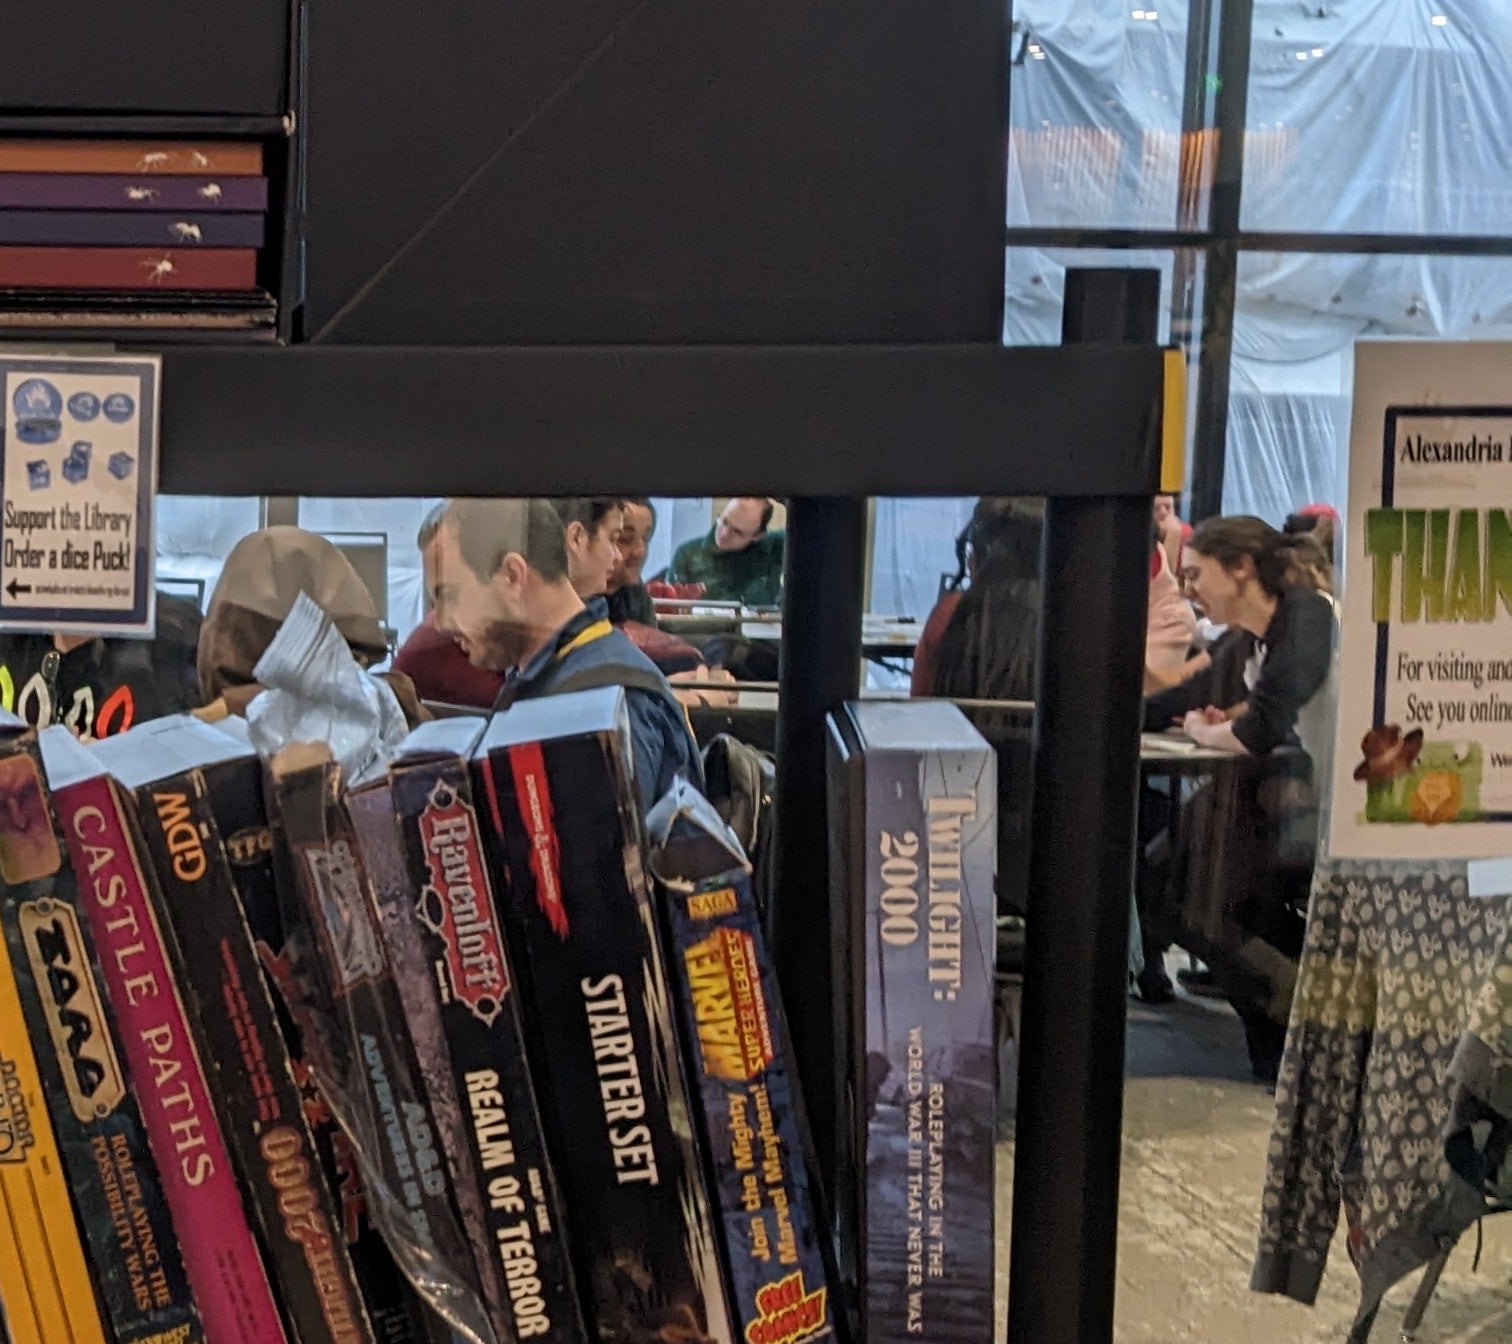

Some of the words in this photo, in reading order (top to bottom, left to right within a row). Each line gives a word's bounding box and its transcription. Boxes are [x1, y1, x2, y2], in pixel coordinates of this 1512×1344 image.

[1400, 434, 1503, 463] Alexandria
[4, 539, 46, 567] Order
[49, 550, 57, 568] a
[62, 540, 89, 569] dice
[93, 545, 131, 571] Puck!
[5, 501, 56, 535] Support
[60, 504, 80, 530] the
[84, 502, 131, 538] Library
[1396, 652, 1423, 683] For
[1427, 652, 1483, 687] visiting
[1406, 694, 1434, 722] See
[1438, 697, 1466, 729] you
[153, 790, 208, 883] GDW
[531, 831, 551, 850] &
[427, 815, 503, 995] Ravenloft
[690, 893, 735, 917] SAGA
[877, 829, 919, 946] 2000
[73, 804, 159, 1008] CASTLE
[139, 1027, 215, 1189] PATHS
[723, 929, 755, 1006] HEROES
[679, 936, 748, 1084] MARVEL
[739, 1007, 767, 1072] SUPER
[580, 974, 649, 1124] STARTER
[906, 1025, 922, 1098] WORLD
[356, 1029, 416, 1179] ADVENTURES
[463, 1068, 518, 1171] REALM
[721, 1089, 760, 1171] Mighty
[745, 1080, 789, 1184] Mayhem!
[906, 1101, 922, 1142] WAR
[605, 1119, 660, 1193] SET
[906, 1147, 921, 1167] III
[925, 1082, 943, 1209] ROLEPLAYING
[108, 1130, 161, 1268] ROLEPLAYING
[148, 1267, 173, 1308] THE
[259, 1125, 329, 1244] 2000
[487, 1174, 518, 1215] OF
[736, 1173, 764, 1213] the
[906, 1172, 922, 1221] THAT
[88, 1132, 137, 1253] POSSIBILITY
[122, 1253, 154, 1313] WARS
[744, 1214, 774, 1264] Join
[765, 1184, 801, 1265] Marvel
[905, 1225, 922, 1286] NEVER
[926, 1215, 944, 1236] IN
[927, 1241, 943, 1277] THE
[495, 1222, 552, 1340] TERROR
[905, 1291, 923, 1333] WAS
